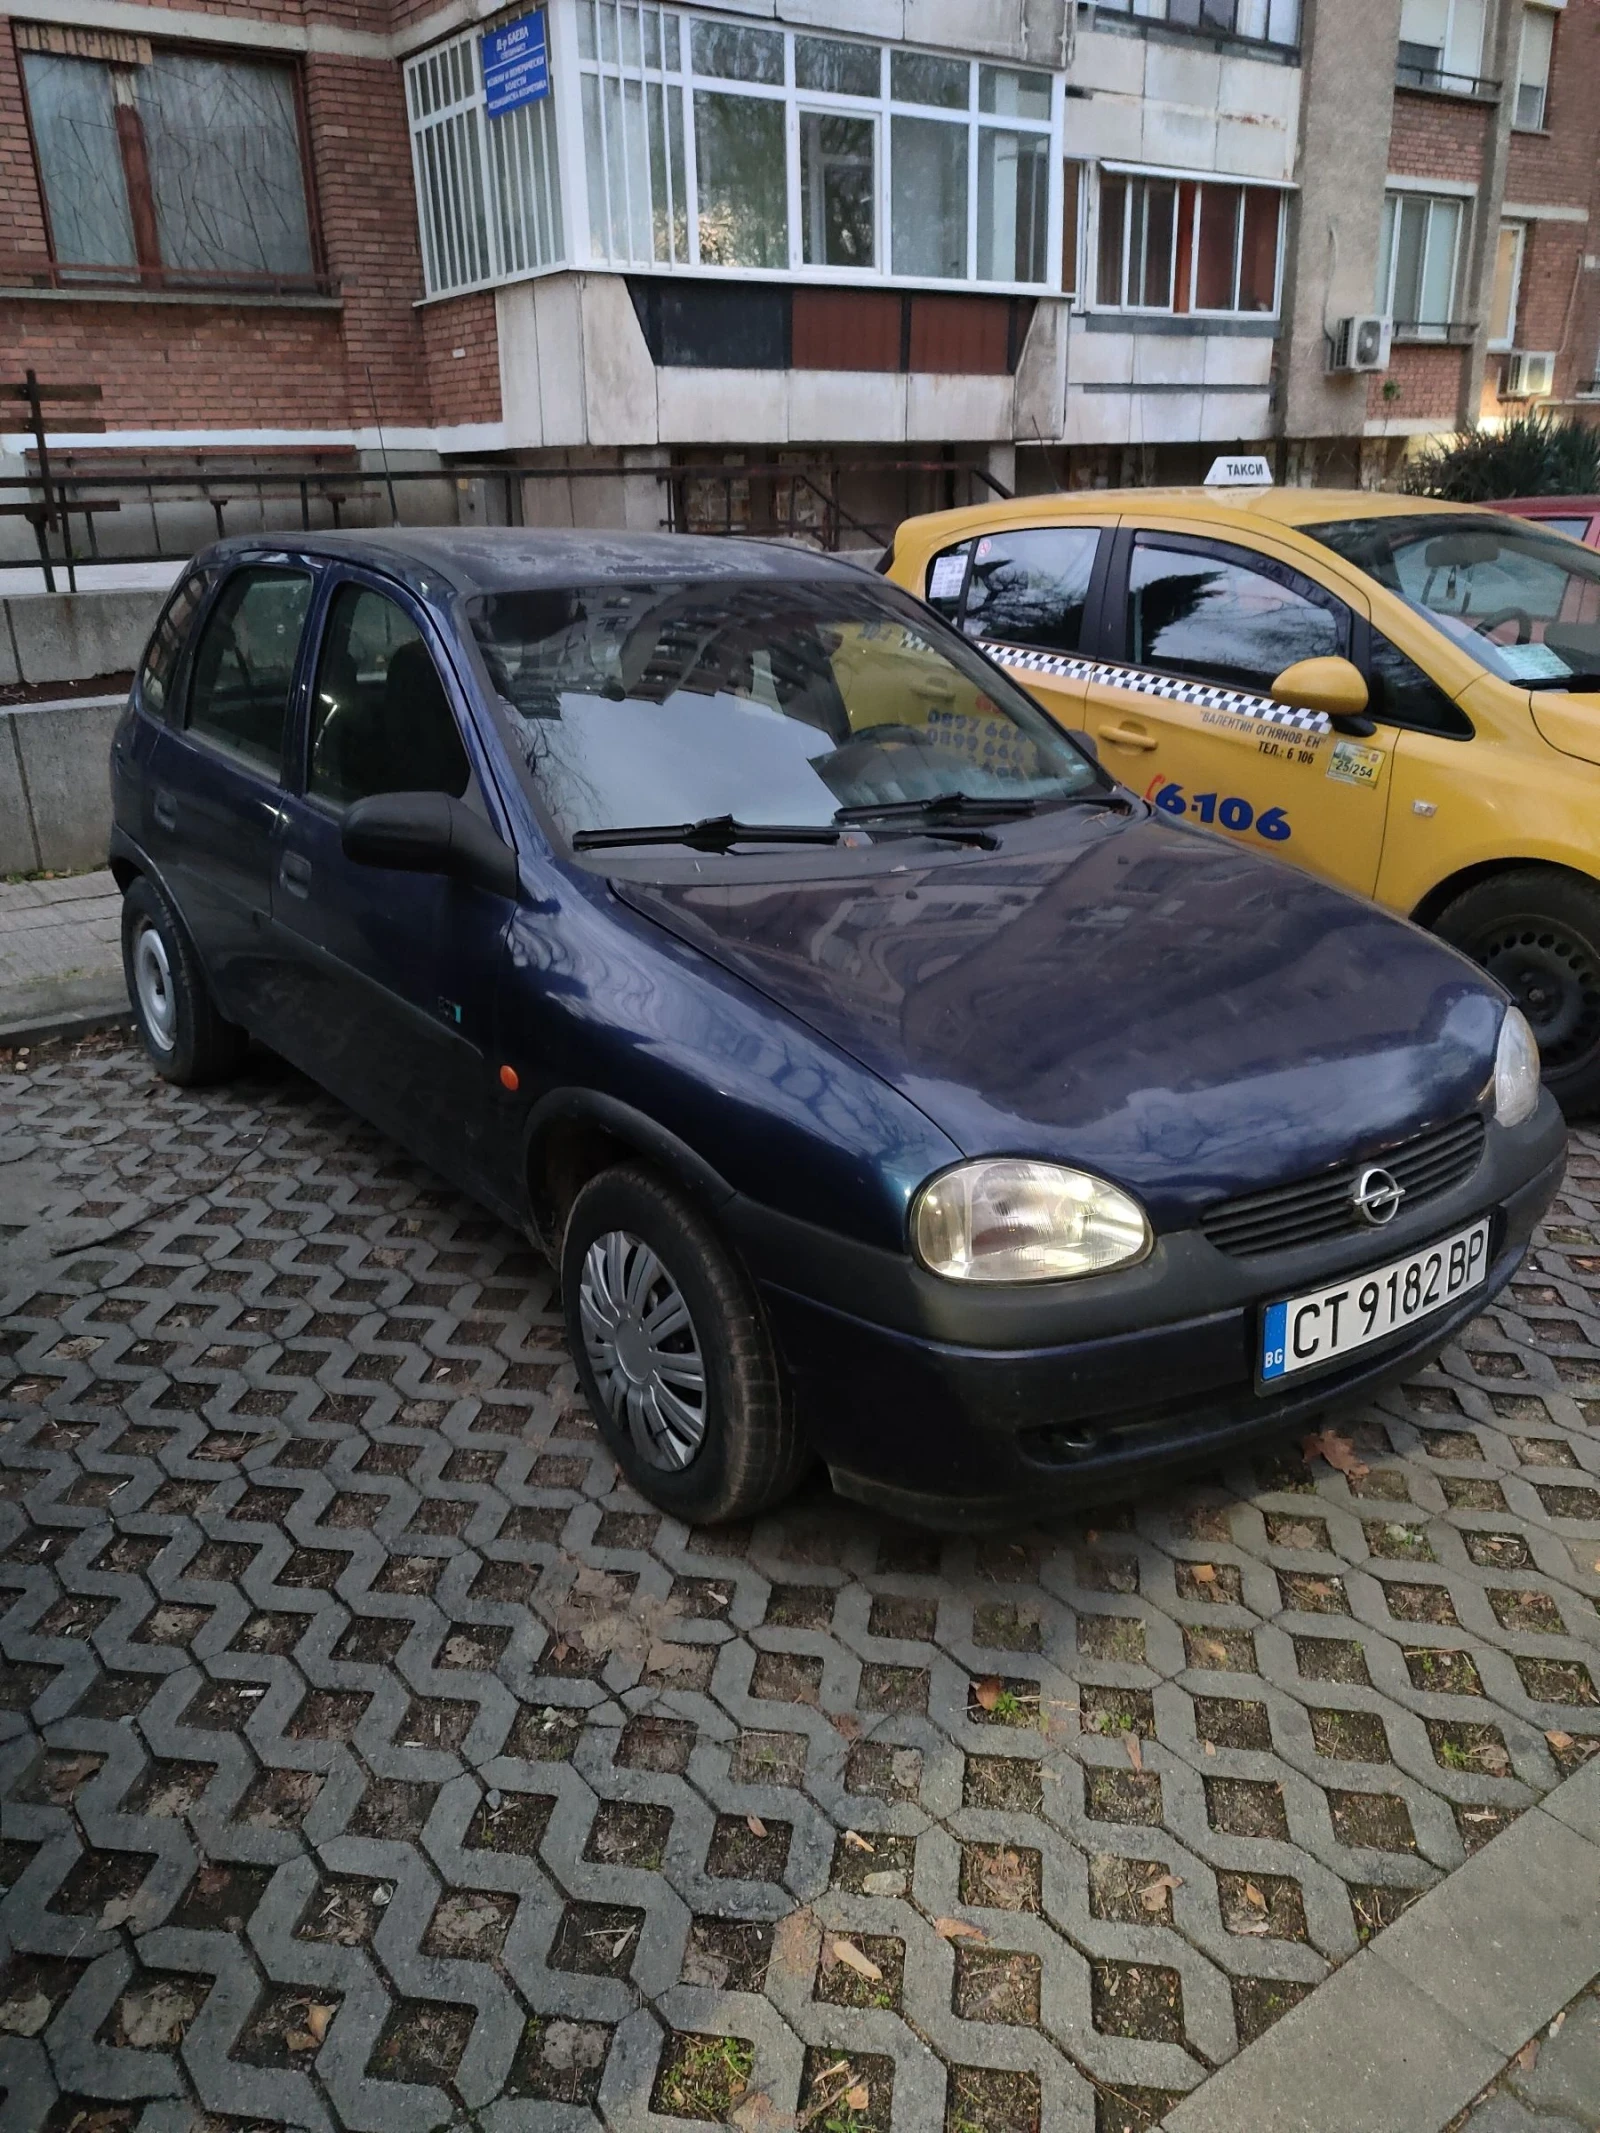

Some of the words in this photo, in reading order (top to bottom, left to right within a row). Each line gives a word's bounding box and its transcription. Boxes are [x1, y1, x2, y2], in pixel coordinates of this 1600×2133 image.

[1226, 463, 1264, 476] ТАКСИ
[1258, 741, 1284, 758] ТЕЛ.:
[1287, 748, 1294, 760] 6
[1297, 750, 1315, 764] 106
[1335, 760, 1374, 779] 25/254
[1292, 1290, 1349, 1359] CT
[1358, 1253, 1442, 1336] 9182
[1447, 1229, 1484, 1294] BP
[1265, 1348, 1284, 1369] BG
